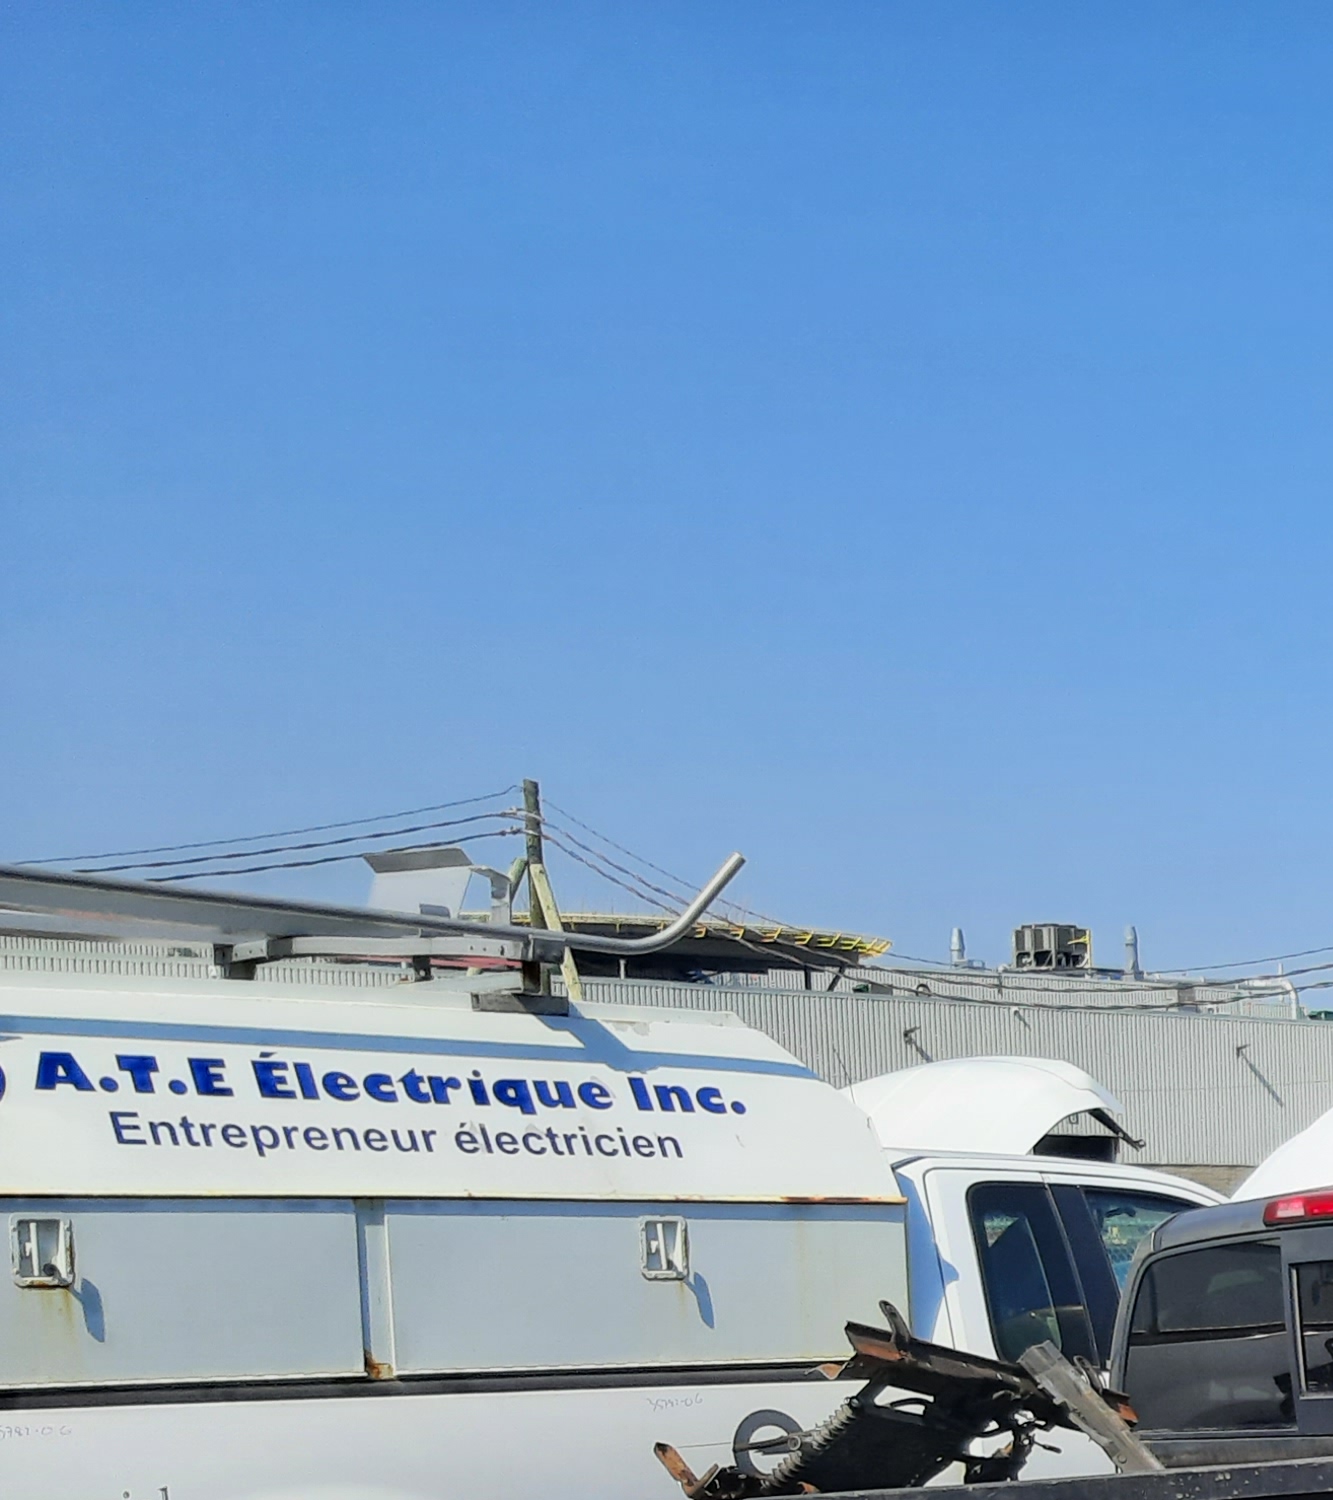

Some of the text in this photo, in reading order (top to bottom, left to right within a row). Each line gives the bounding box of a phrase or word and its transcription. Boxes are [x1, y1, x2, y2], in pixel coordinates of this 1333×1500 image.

[34, 1051, 747, 1115] A.T.E Électrique Inc.
[109, 1111, 684, 1158] Entrepreneur électricien
